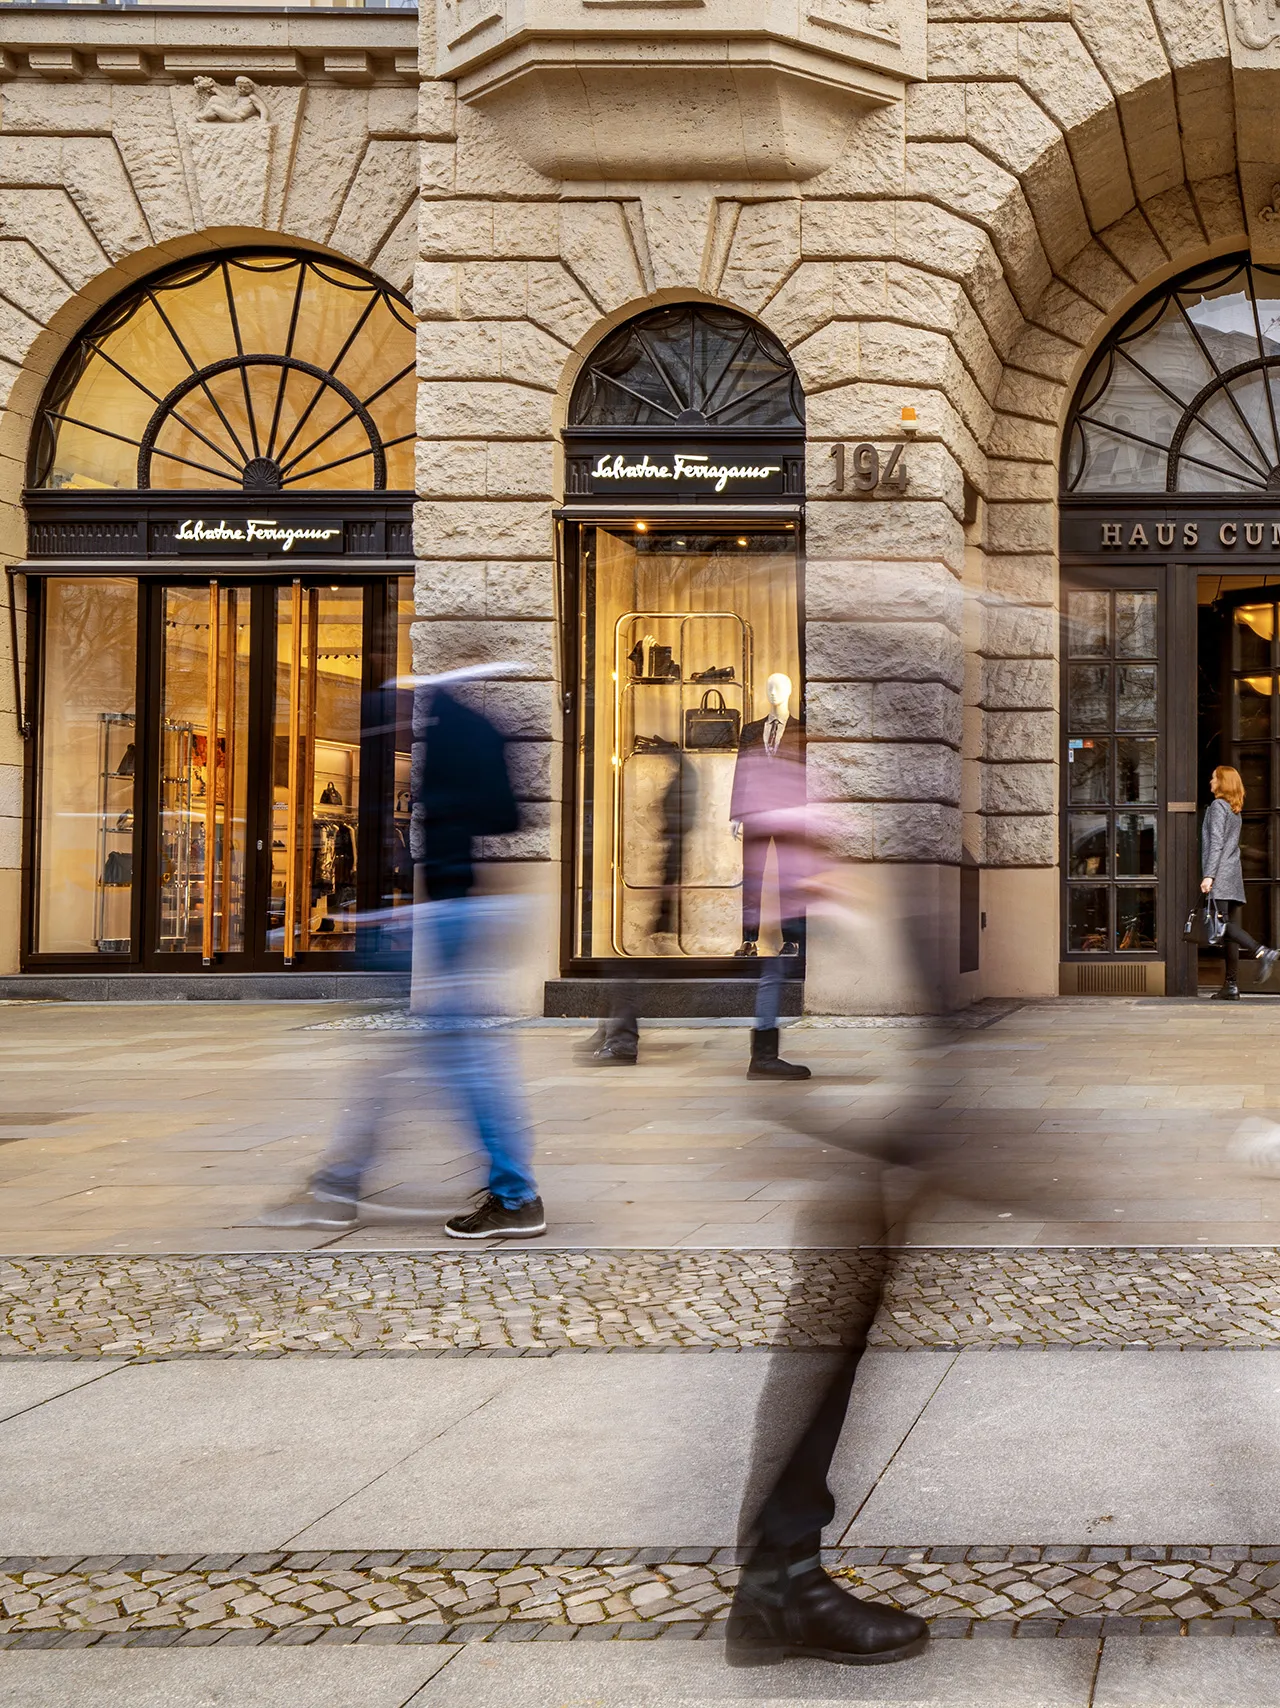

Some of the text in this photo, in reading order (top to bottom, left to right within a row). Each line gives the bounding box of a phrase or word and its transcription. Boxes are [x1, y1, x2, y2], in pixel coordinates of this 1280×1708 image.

[591, 454, 781, 492] Salvatore Ferragamo
[830, 443, 911, 492] 194
[175, 520, 340, 551] Salvatore Ferragamo
[1101, 522, 1199, 547] HAUS
